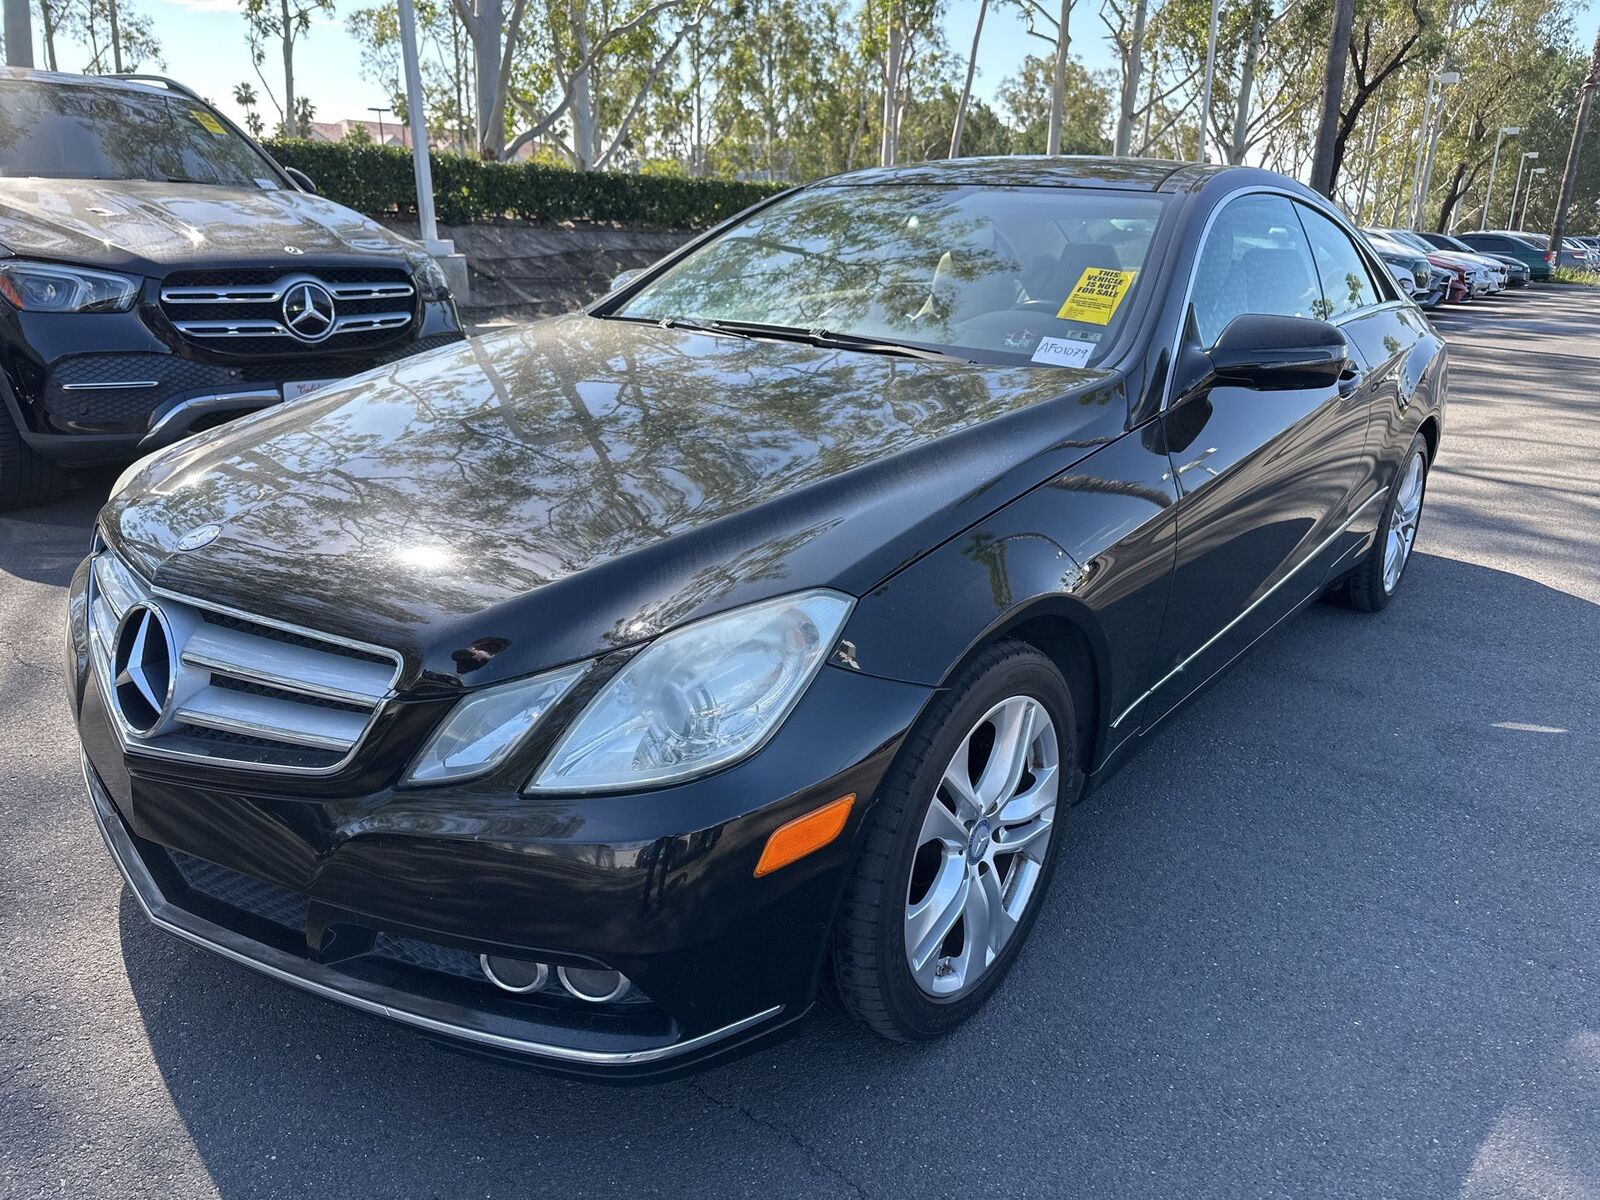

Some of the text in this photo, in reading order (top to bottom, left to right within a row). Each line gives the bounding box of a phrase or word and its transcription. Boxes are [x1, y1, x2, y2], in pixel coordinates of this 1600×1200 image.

[1099, 270, 1120, 278] THIS
[1087, 275, 1124, 285] VEHICLE
[1097, 282, 1117, 290] NOT
[1077, 286, 1095, 294] FOR
[1096, 289, 1118, 298] SALE
